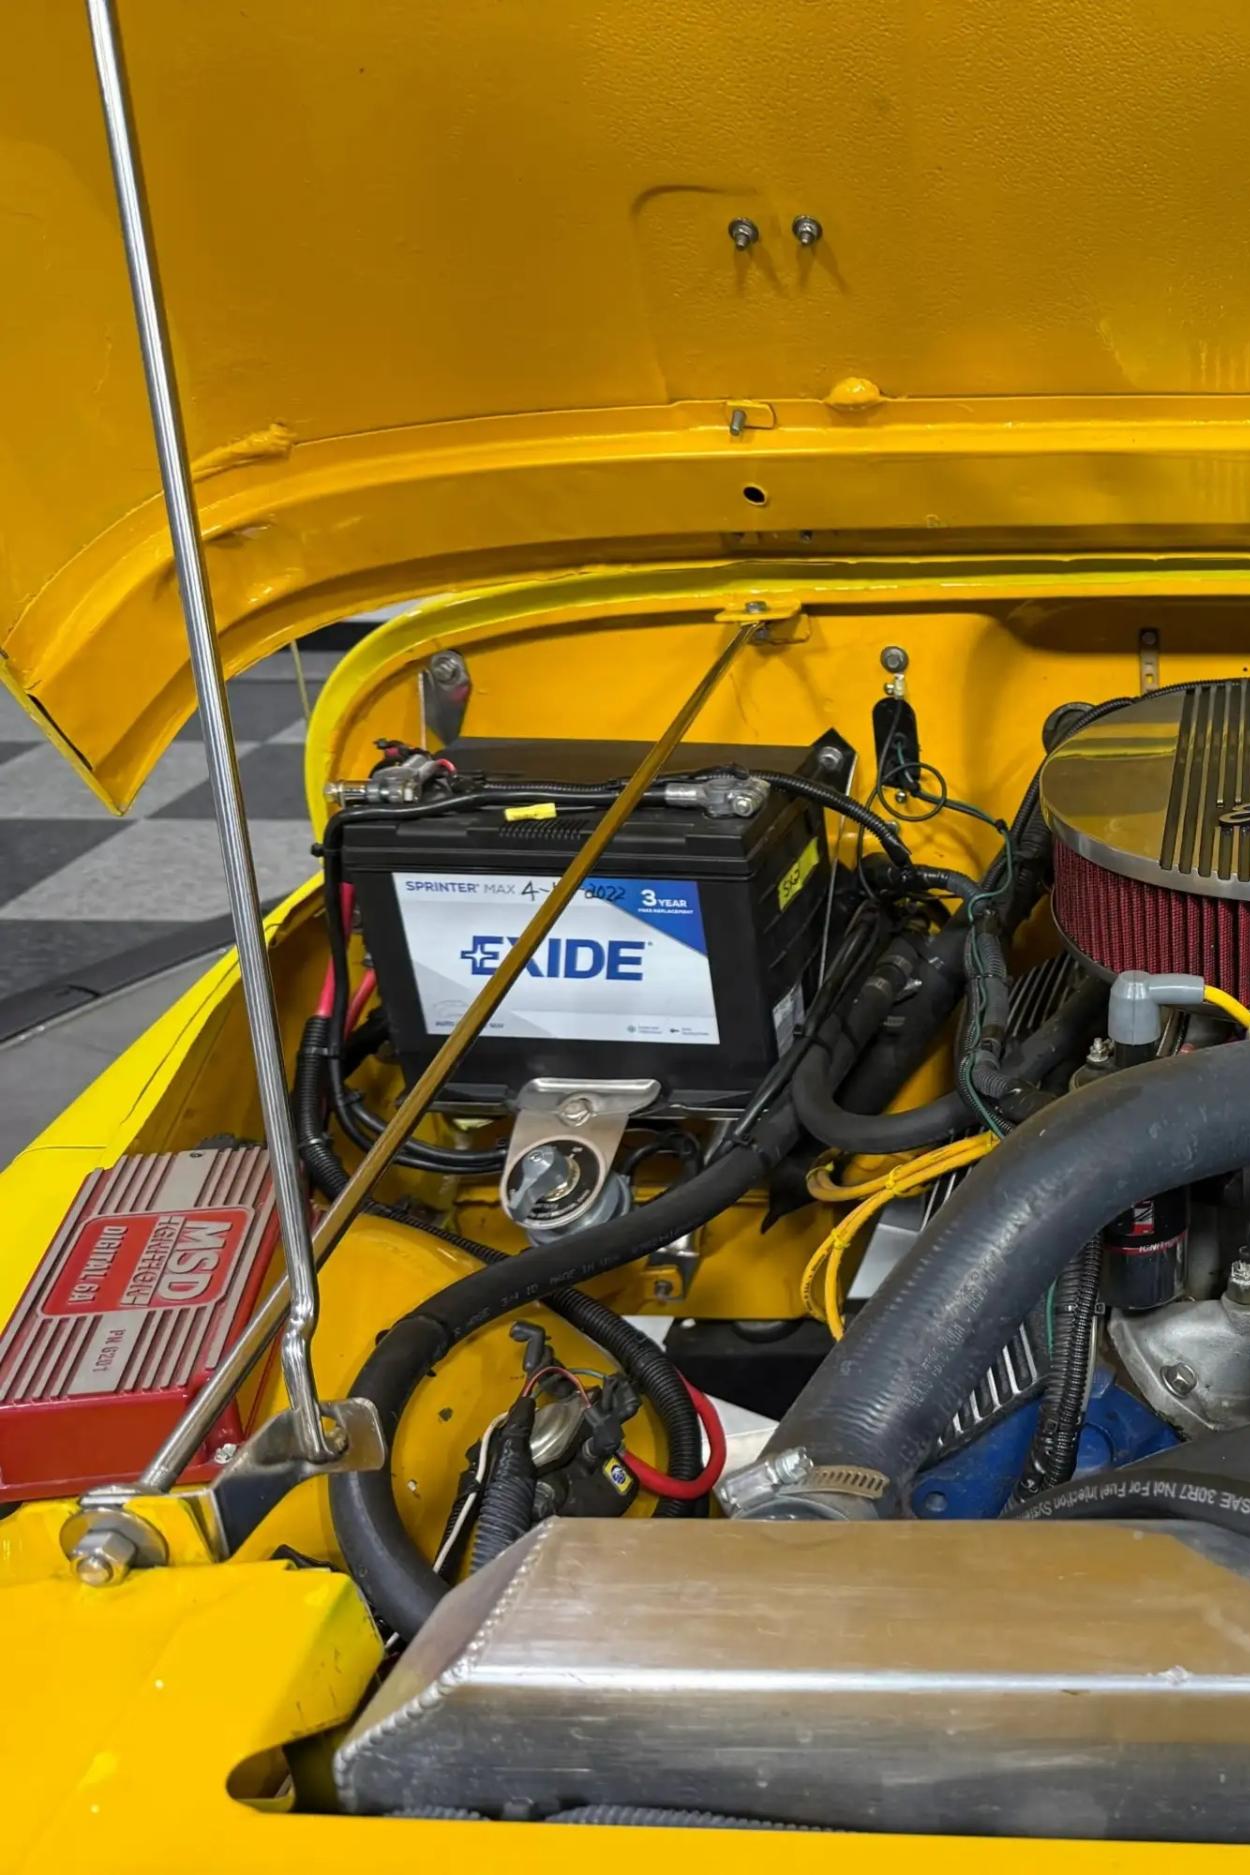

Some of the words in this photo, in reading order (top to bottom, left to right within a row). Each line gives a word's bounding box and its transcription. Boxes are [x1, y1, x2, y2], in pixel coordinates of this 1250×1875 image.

[405, 880, 477, 894] SPRINTER
[483, 884, 515, 895] MAX
[640, 889, 657, 907] 3
[658, 899, 687, 908] YEAR
[80, 1225, 128, 1281] DIGITAL
[155, 1220, 233, 1301] MSD
[67, 1282, 101, 1305] 6A
[107, 1328, 126, 1345] PN
[92, 1346, 119, 1373] 6201
[1054, 1484, 1098, 1510] Injection
[1099, 1480, 1127, 1498] Fuel
[1127, 1480, 1150, 1497] For
[1153, 1482, 1177, 1499] Not
[1178, 1486, 1216, 1504] 30R7
